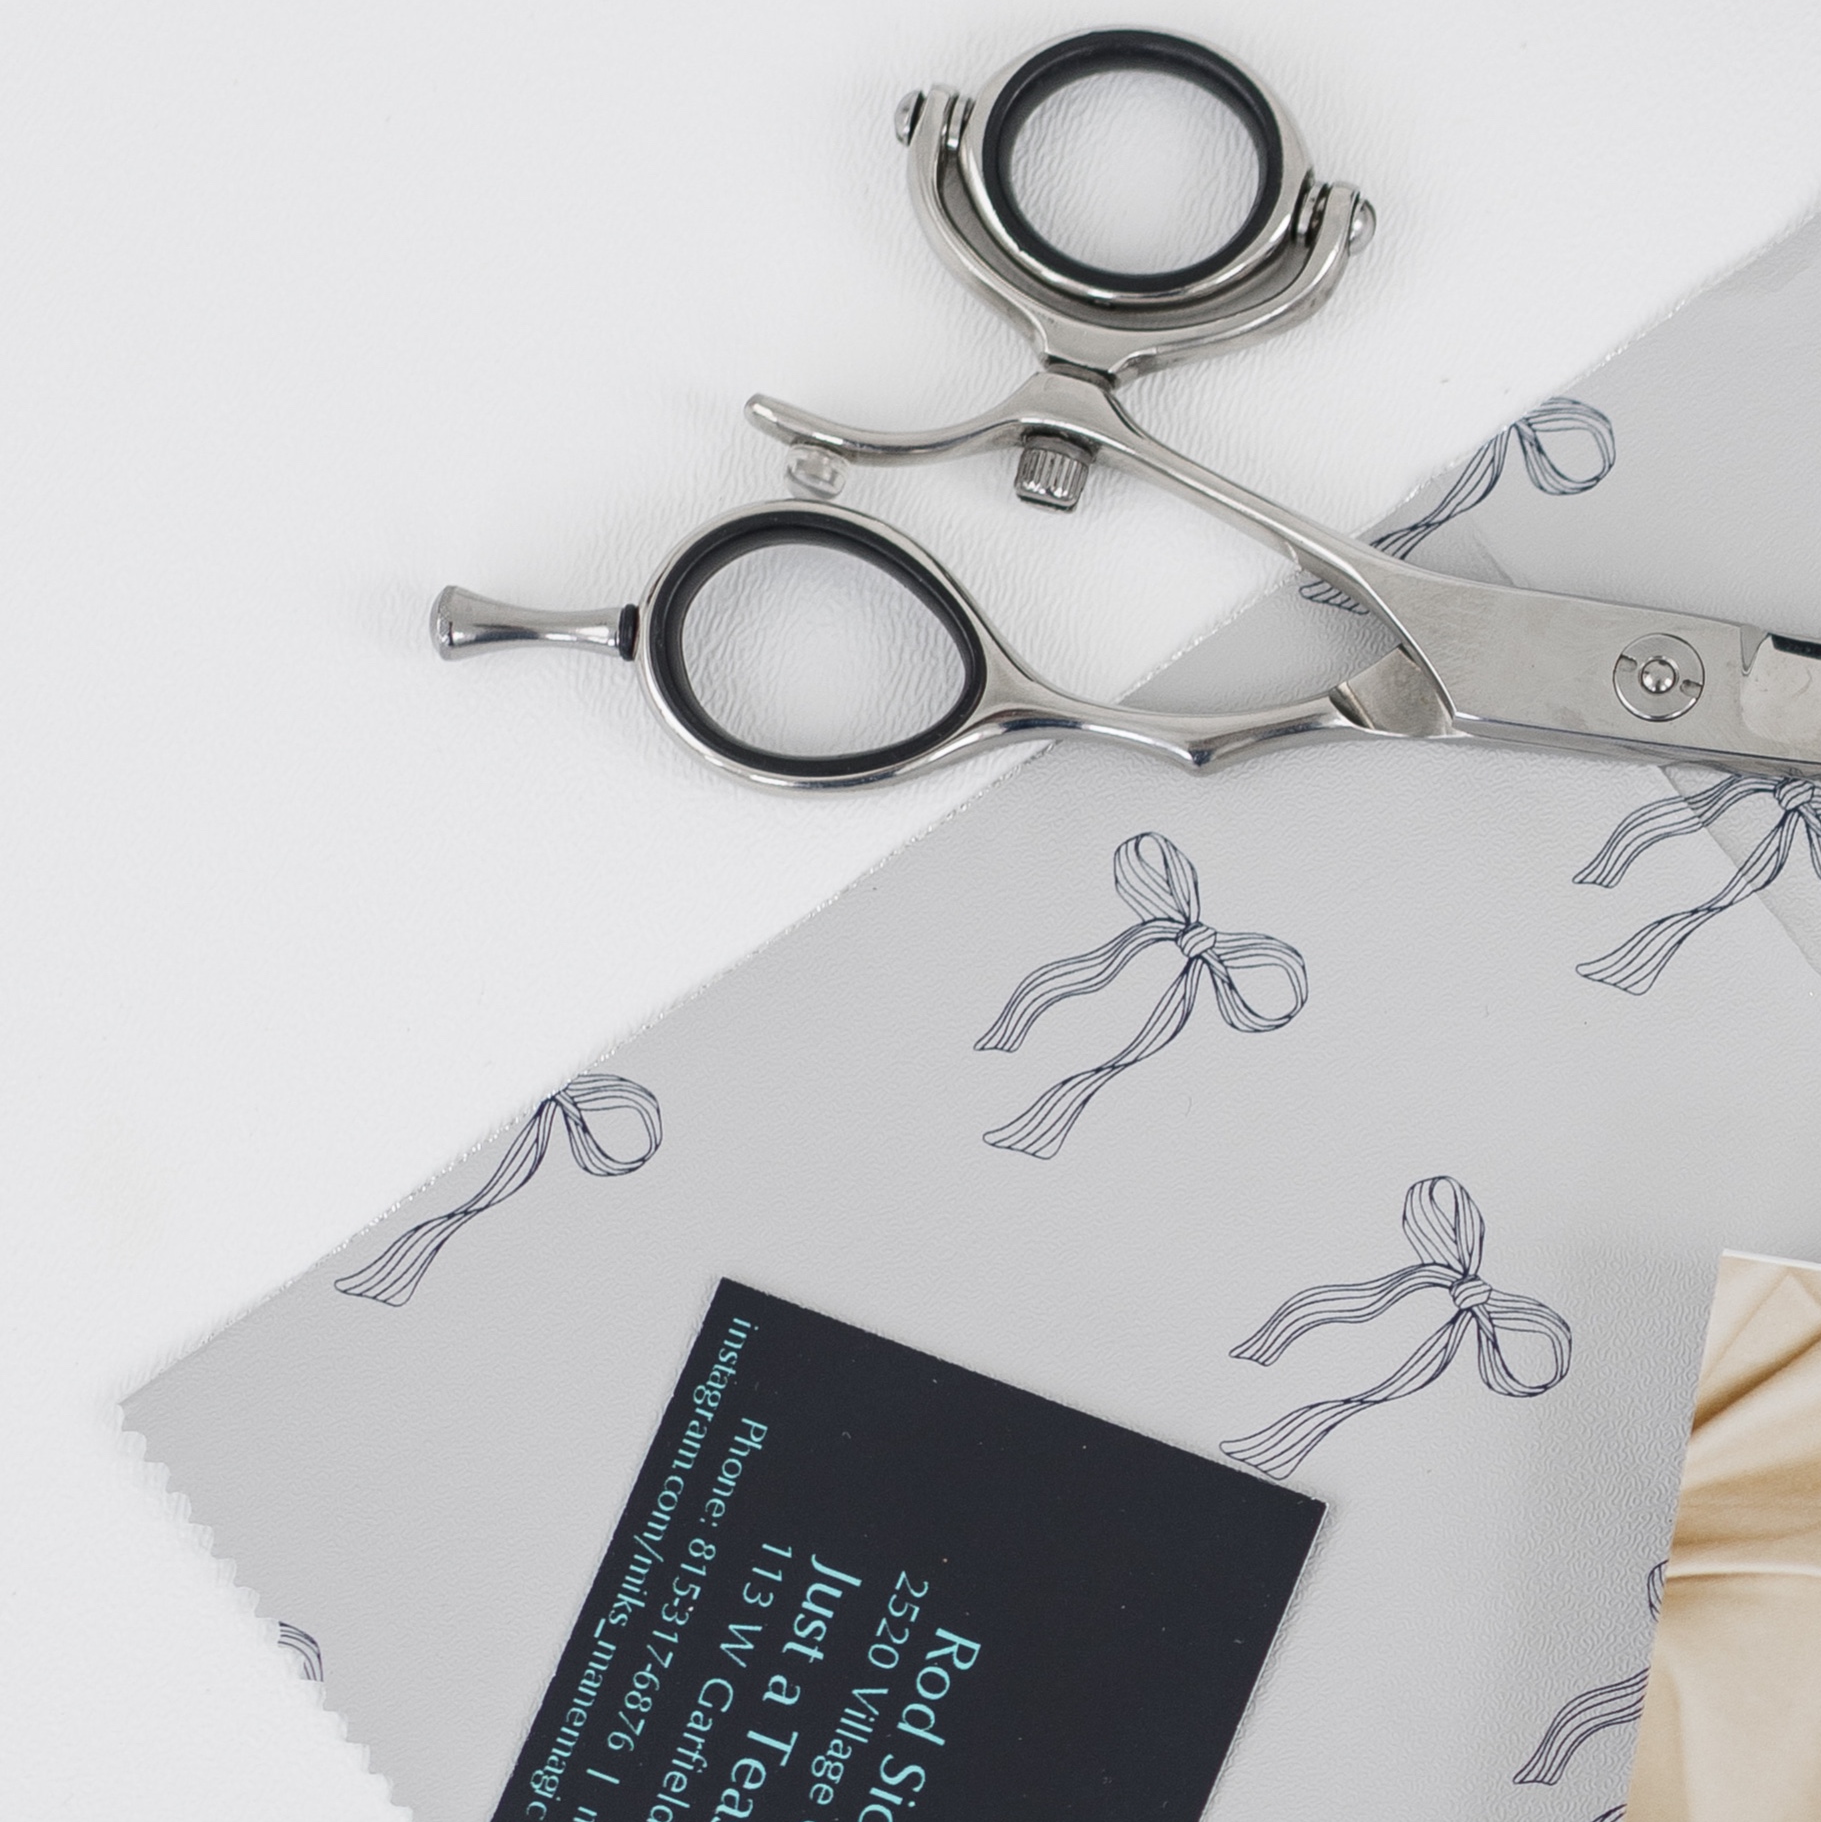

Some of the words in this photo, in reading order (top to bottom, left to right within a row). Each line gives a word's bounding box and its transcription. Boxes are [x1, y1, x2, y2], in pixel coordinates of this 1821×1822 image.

[700, 1417, 768, 1527] Phone:
[742, 1543, 792, 1608] 113
[782, 1553, 862, 1663] Just
[868, 1570, 929, 1670] 2520
[607, 1538, 716, 1751] 815-317-6876
[719, 1624, 763, 1668] W
[762, 1674, 801, 1706] a
[896, 1627, 982, 1746] Rod
[809, 1688, 889, 1805] Village
